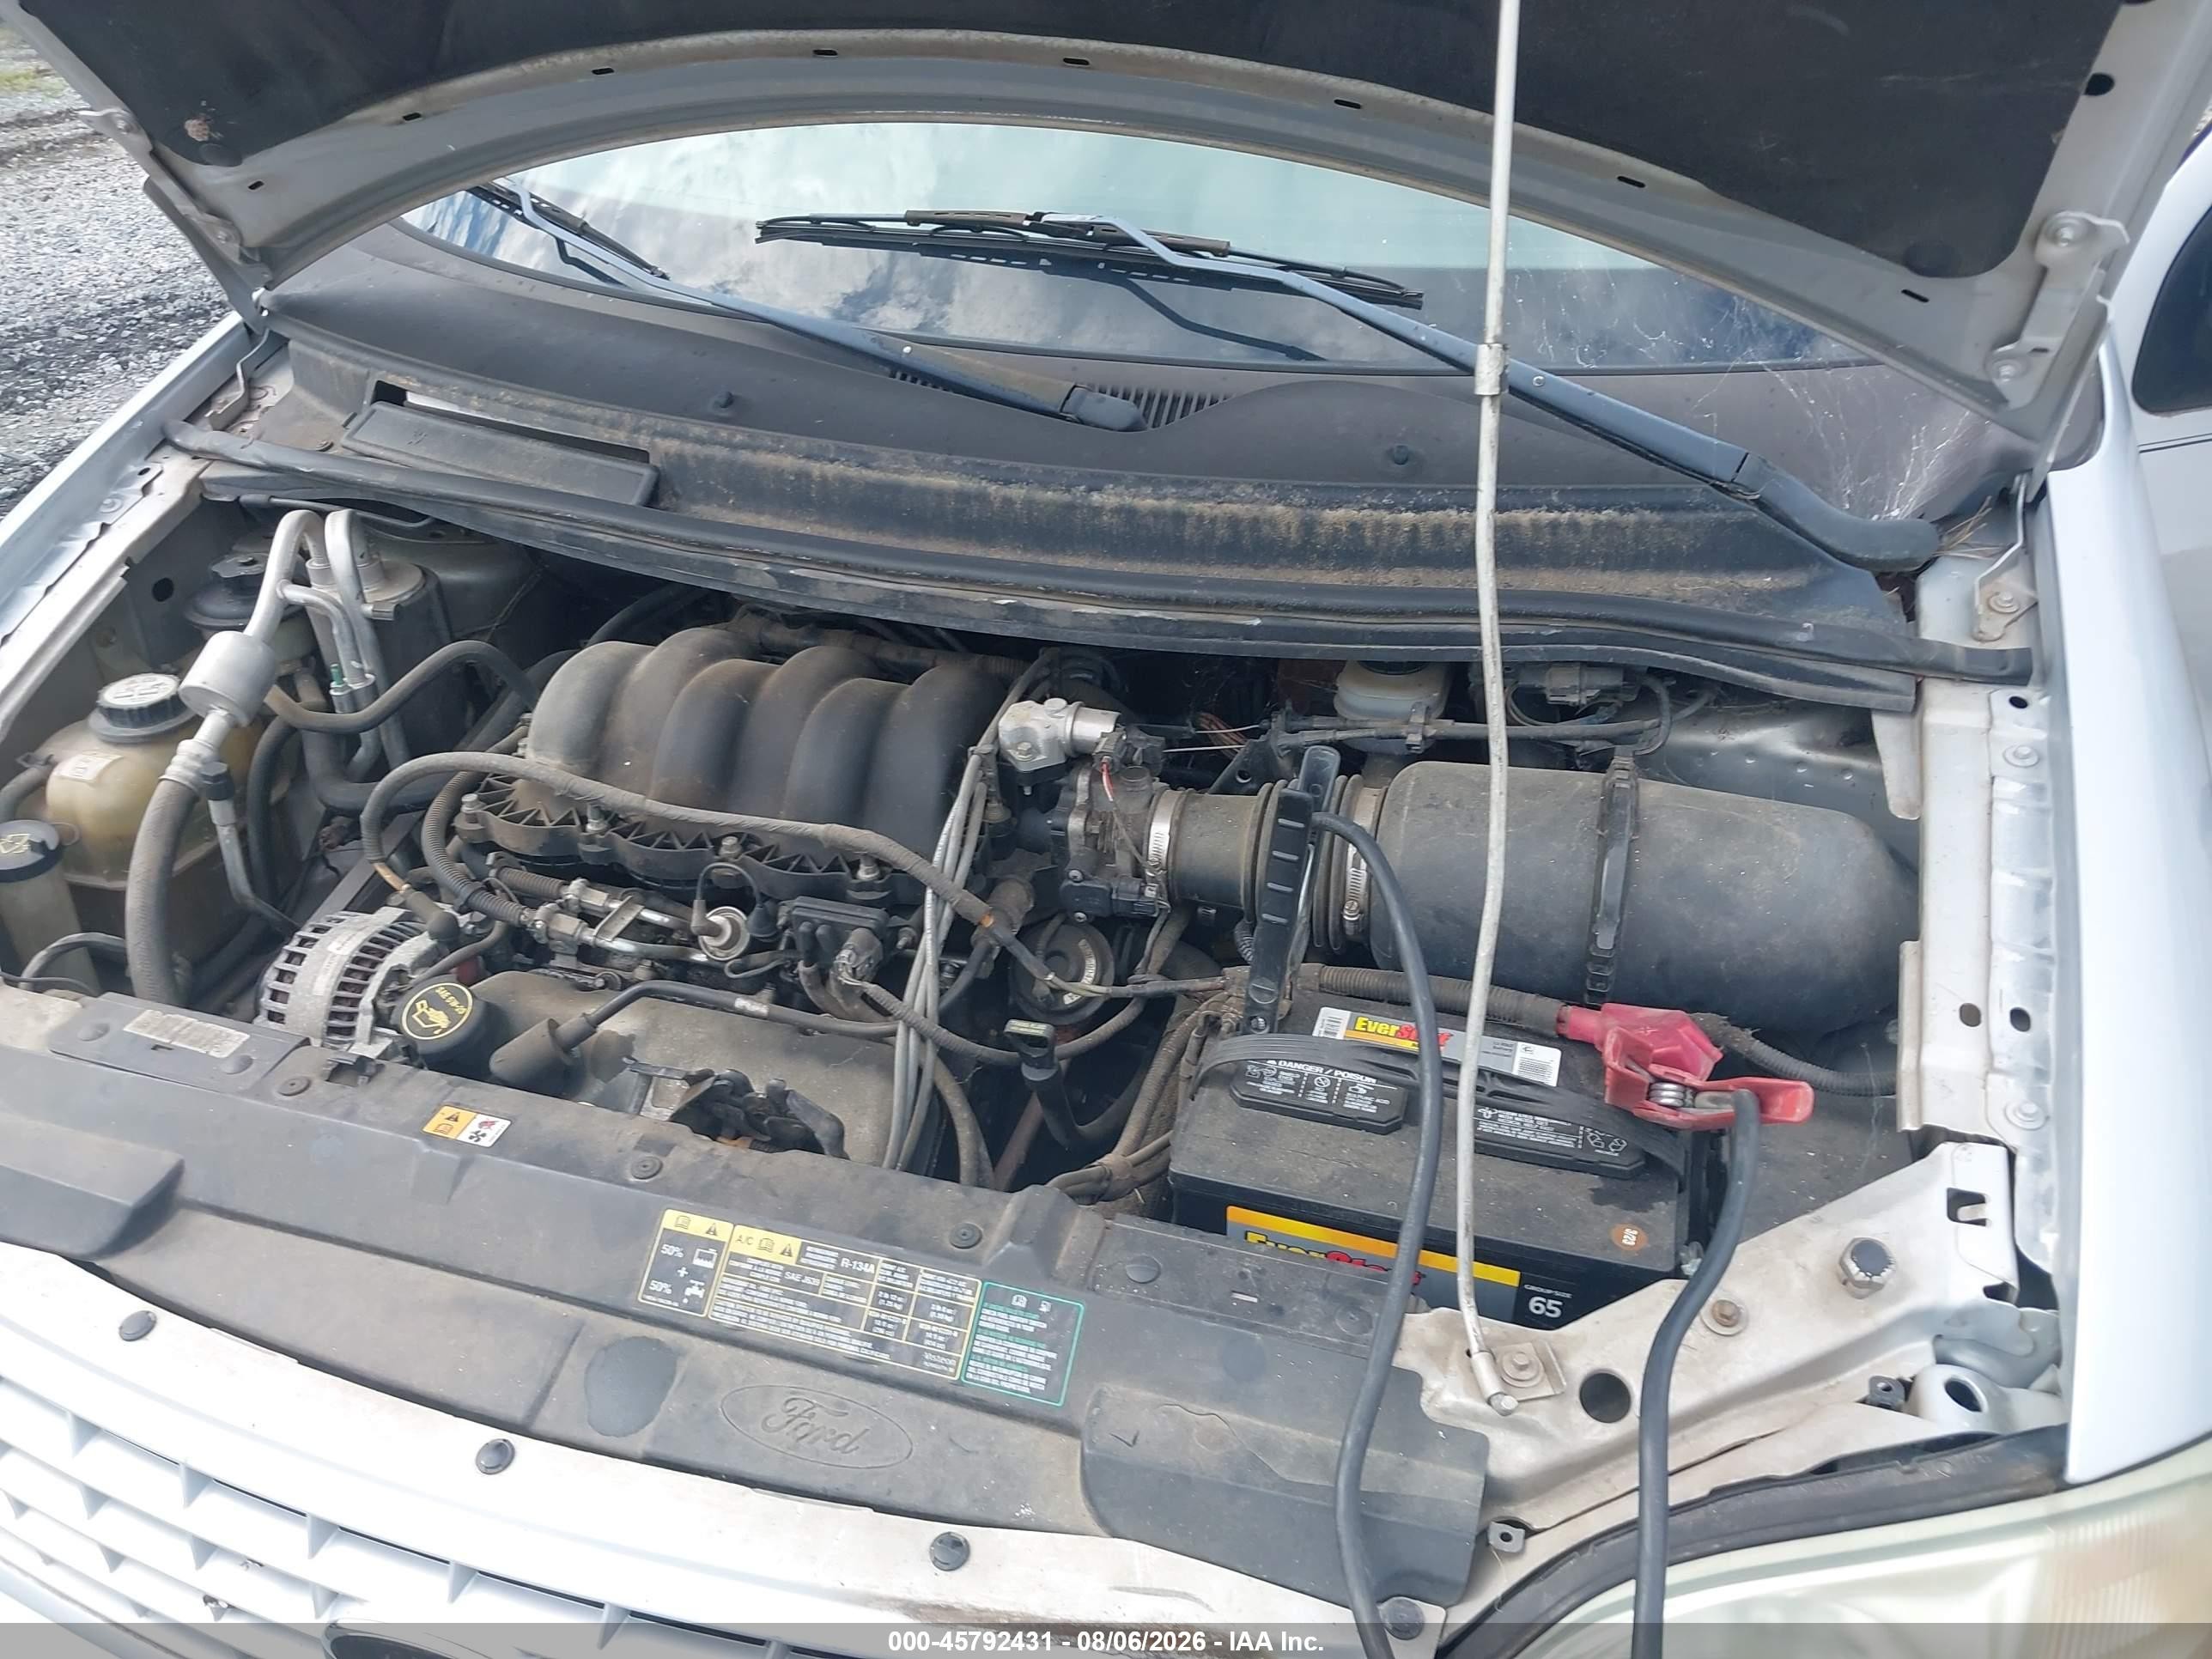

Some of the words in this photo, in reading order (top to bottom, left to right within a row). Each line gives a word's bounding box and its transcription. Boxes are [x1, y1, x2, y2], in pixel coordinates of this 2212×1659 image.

[1278, 1060, 1324, 1073] DANGER
[1334, 1070, 1376, 1084] POISON
[735, 1235, 754, 1246] A/C
[660, 1243, 684, 1258] 50%
[648, 1279, 672, 1294] 50%
[1528, 1296, 1563, 1318] 65
[761, 1397, 870, 1454] Ford
